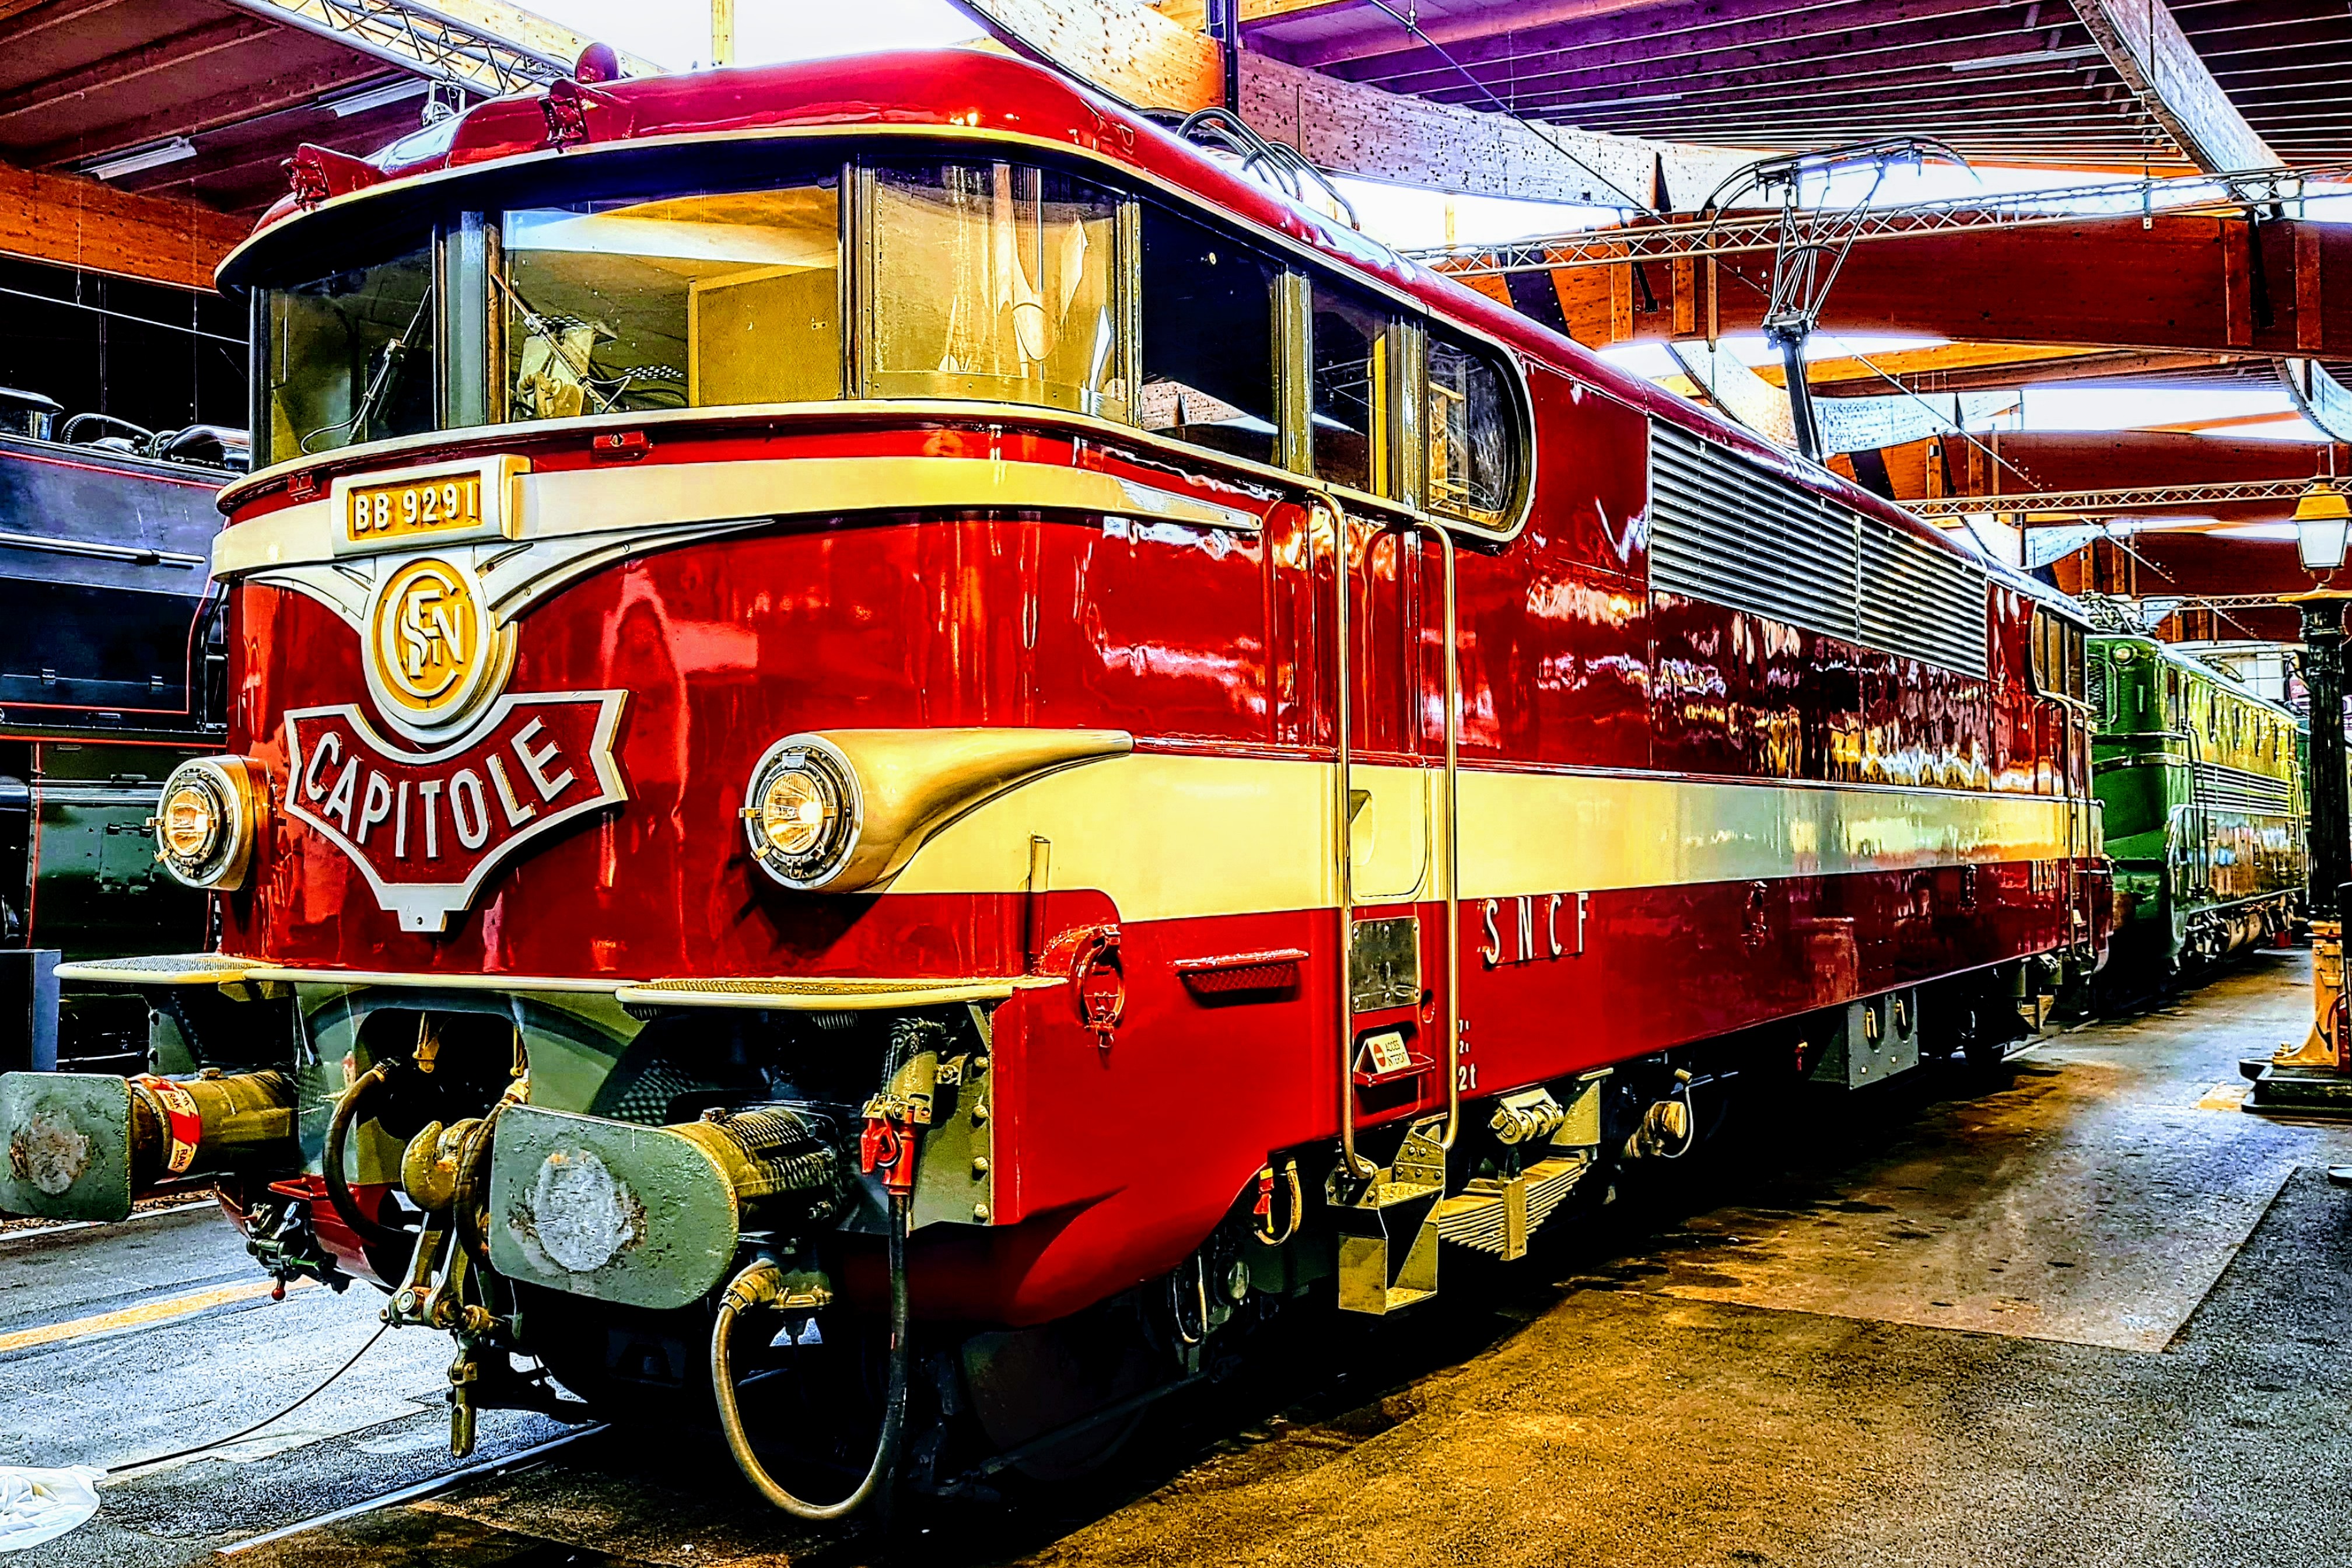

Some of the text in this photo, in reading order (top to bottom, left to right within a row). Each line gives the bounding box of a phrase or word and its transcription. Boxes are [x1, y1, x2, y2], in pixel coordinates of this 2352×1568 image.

[355, 481, 477, 530] BB 9291
[304, 716, 579, 859] CAPITOLE
[175, 1148, 188, 1169] RAK
